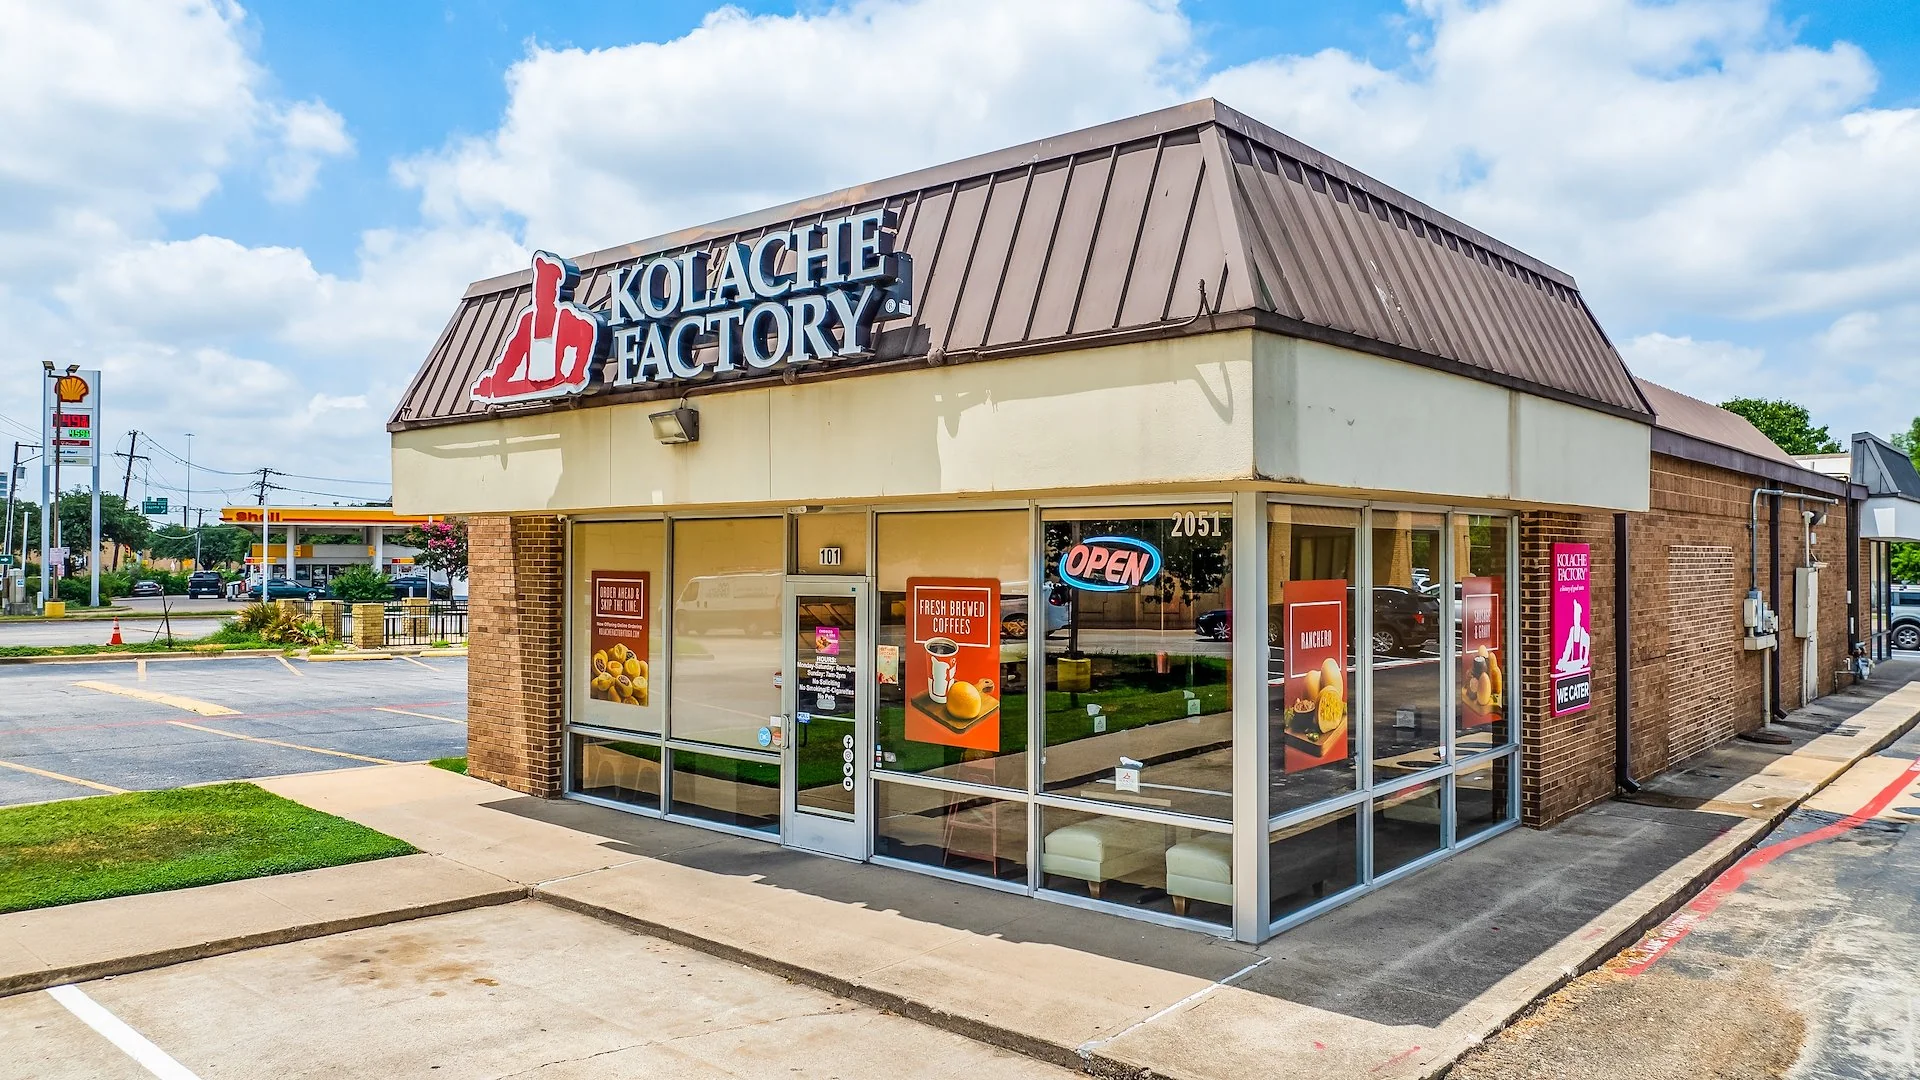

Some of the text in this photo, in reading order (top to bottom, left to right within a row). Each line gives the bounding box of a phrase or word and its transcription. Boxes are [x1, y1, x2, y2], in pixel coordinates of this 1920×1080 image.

[607, 208, 886, 326] KOLACHE
[614, 285, 875, 387] FACTORY
[1171, 511, 1221, 537] 2051
[821, 549, 838, 564] 101
[1066, 544, 1150, 586] OPEN
[1557, 554, 1587, 567] KOLACHE
[1558, 568, 1586, 581] FACTORY
[600, 586, 639, 599] ORDER AHEAD &
[600, 599, 612, 610] SKIP
[614, 600, 623, 611] THE
[920, 599, 984, 617] FRESH BREWED
[933, 617, 971, 634] COFFEES
[1301, 630, 1332, 649] RANCHERO
[1557, 682, 1589, 704] WE CATER
